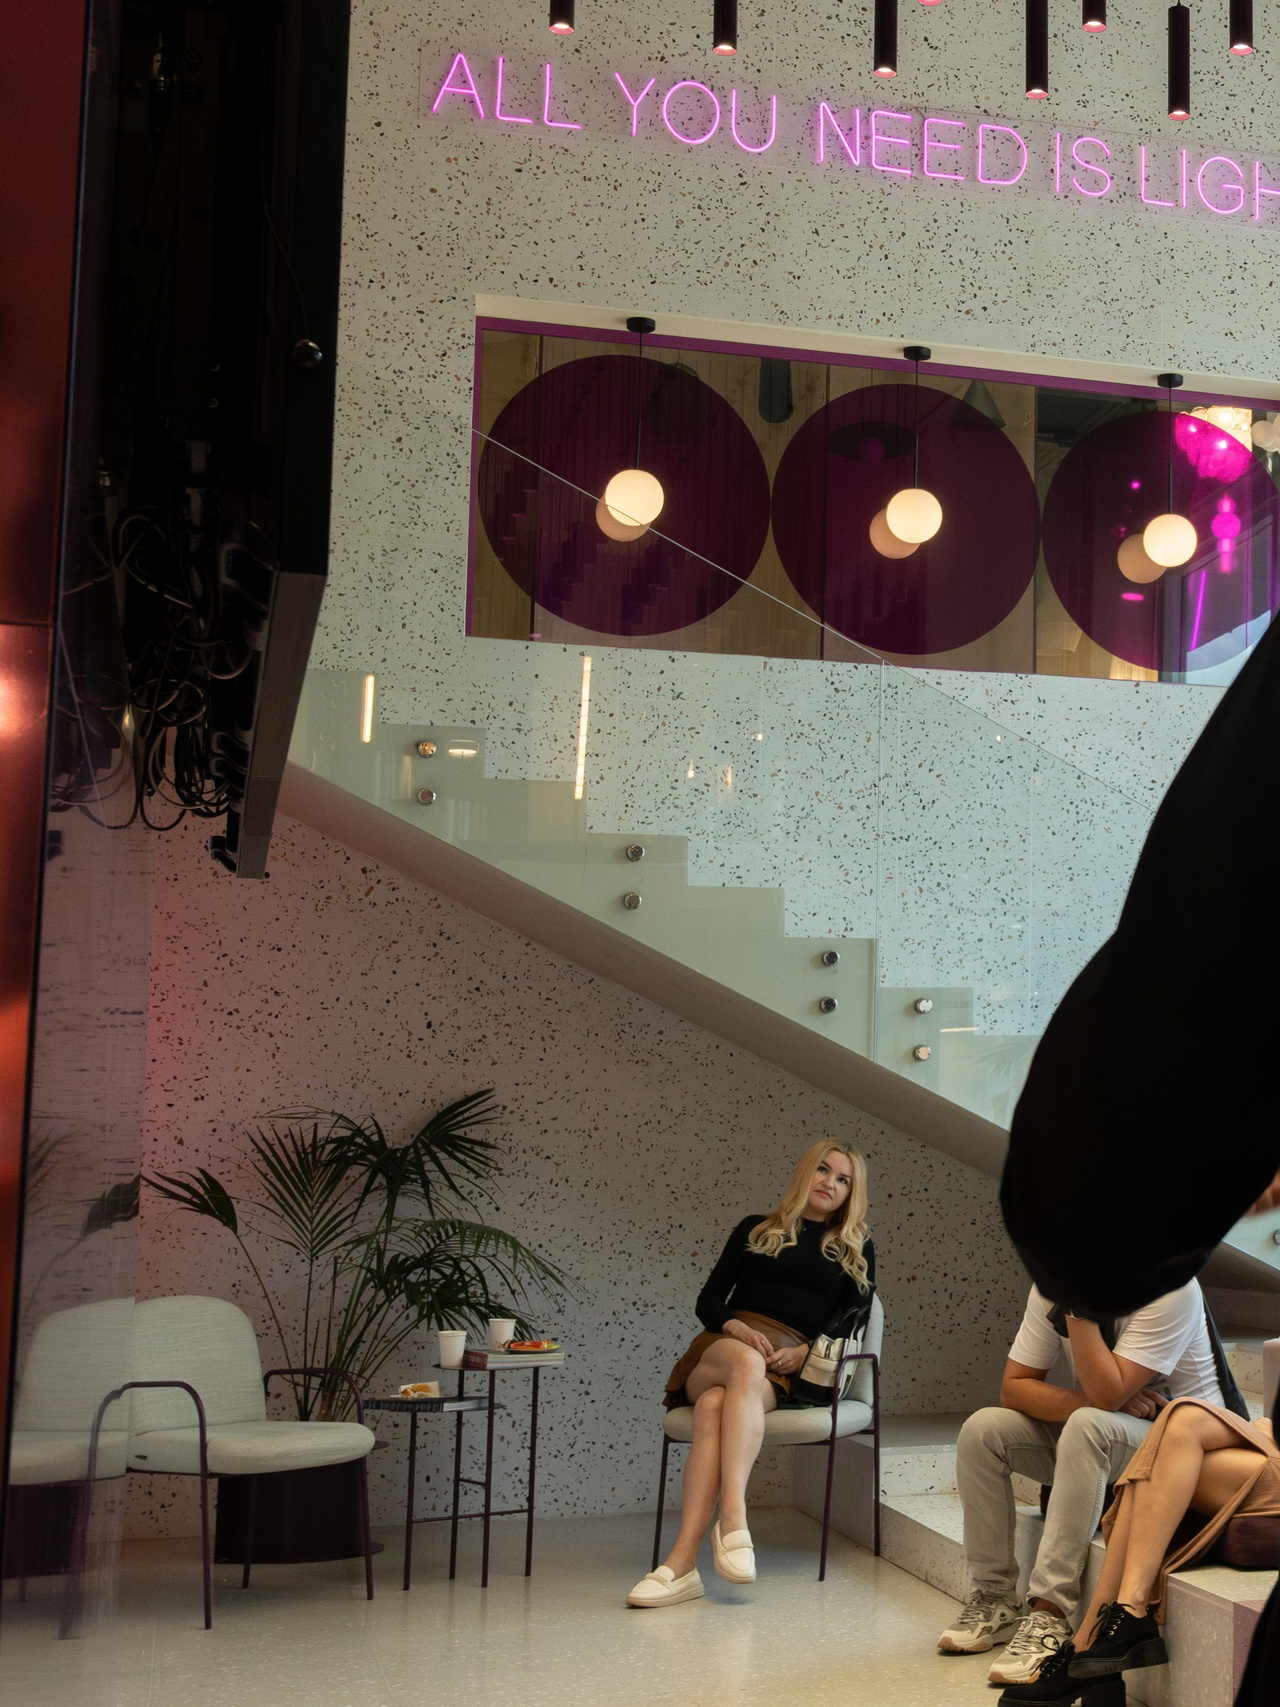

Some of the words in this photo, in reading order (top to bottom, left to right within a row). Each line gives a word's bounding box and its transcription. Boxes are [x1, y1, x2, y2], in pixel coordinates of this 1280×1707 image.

[432, 52, 582, 129] ALL
[615, 72, 777, 152] YOU
[816, 101, 1029, 186] NEED
[1055, 132, 1112, 197] IS
